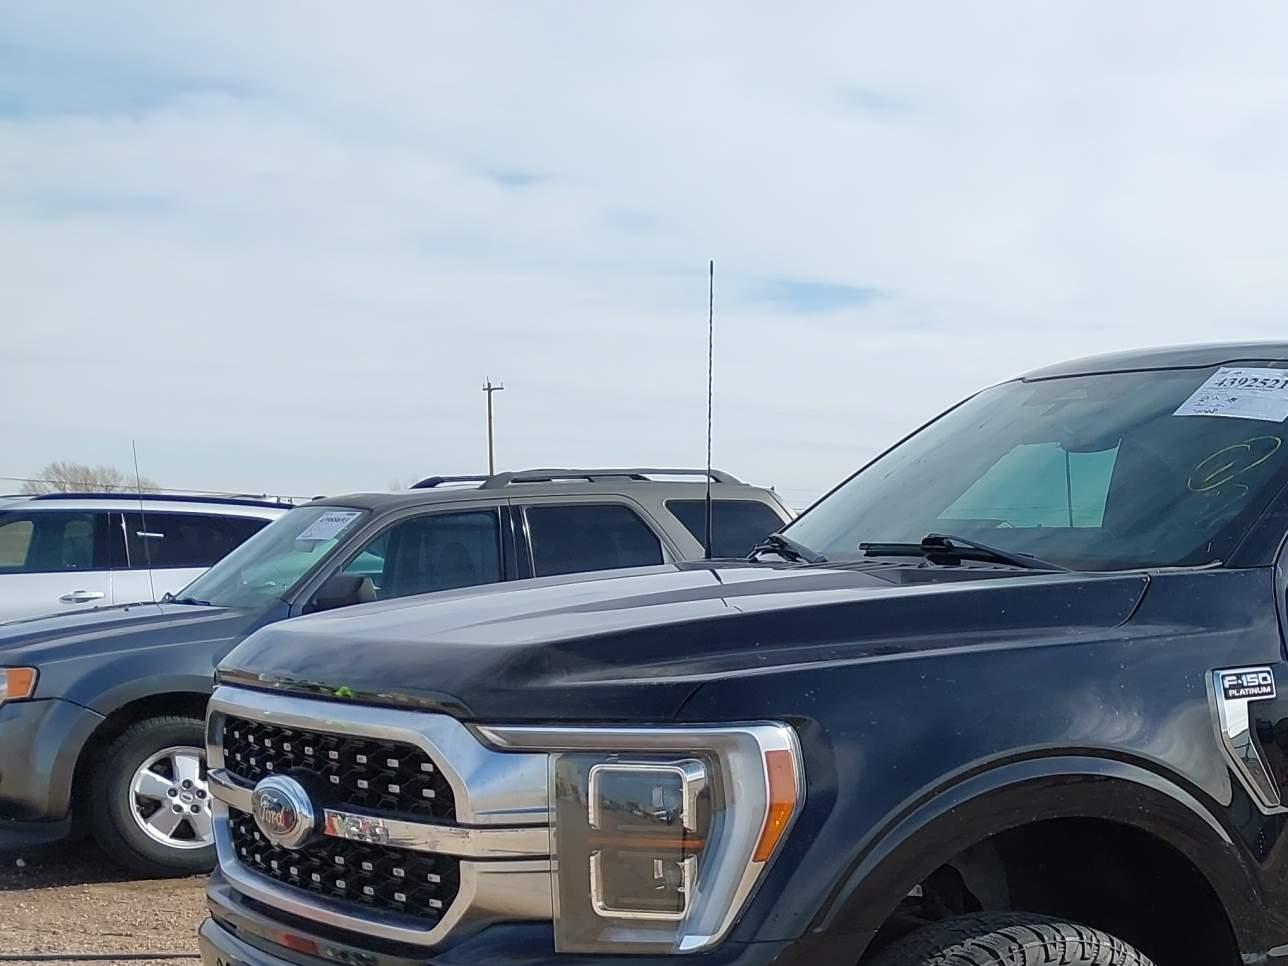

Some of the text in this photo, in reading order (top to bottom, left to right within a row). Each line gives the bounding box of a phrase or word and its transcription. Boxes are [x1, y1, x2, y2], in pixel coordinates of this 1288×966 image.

[1223, 672, 1272, 688] F-150
[1228, 685, 1272, 697] PLATINUM
[258, 793, 286, 827] Ford
